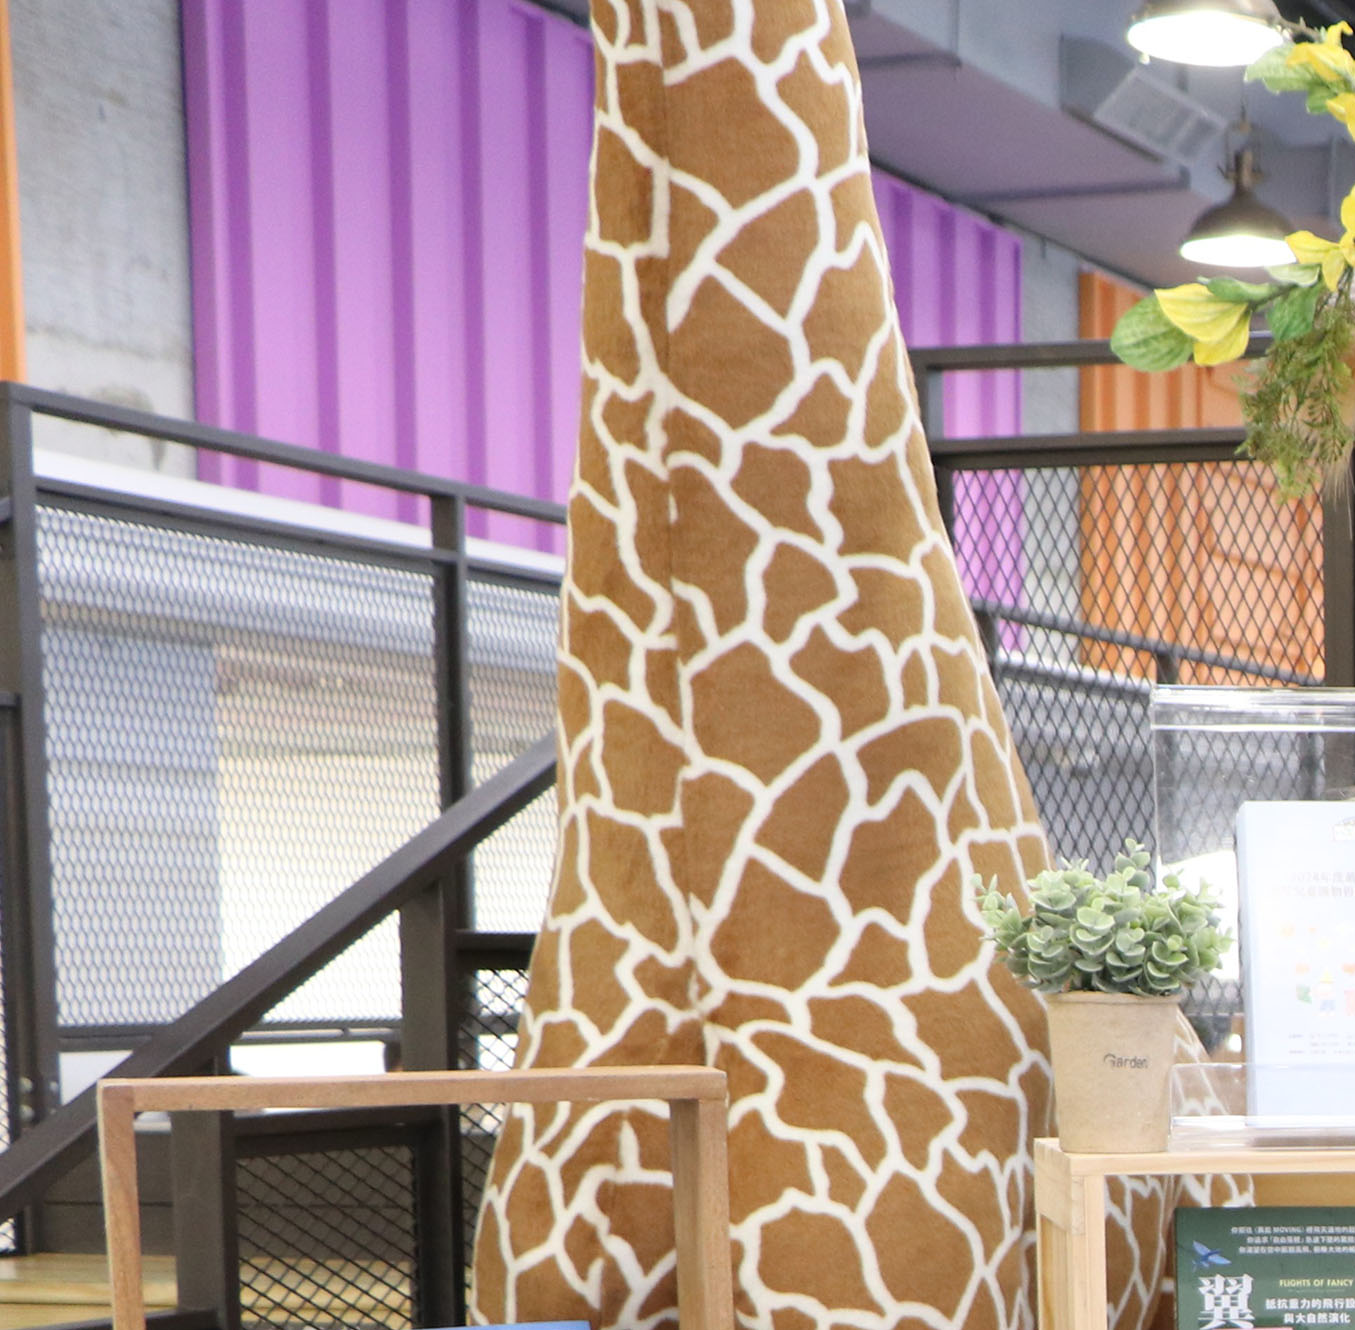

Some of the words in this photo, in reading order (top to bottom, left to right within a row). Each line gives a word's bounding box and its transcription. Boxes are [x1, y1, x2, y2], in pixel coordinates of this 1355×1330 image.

[1103, 1053, 1149, 1069] Garden
[1279, 1279, 1311, 1288] FLIGHTS
[1313, 1279, 1324, 1287] OF
[1326, 1279, 1354, 1287] FANCY
[1198, 1273, 1256, 1330] 翼
